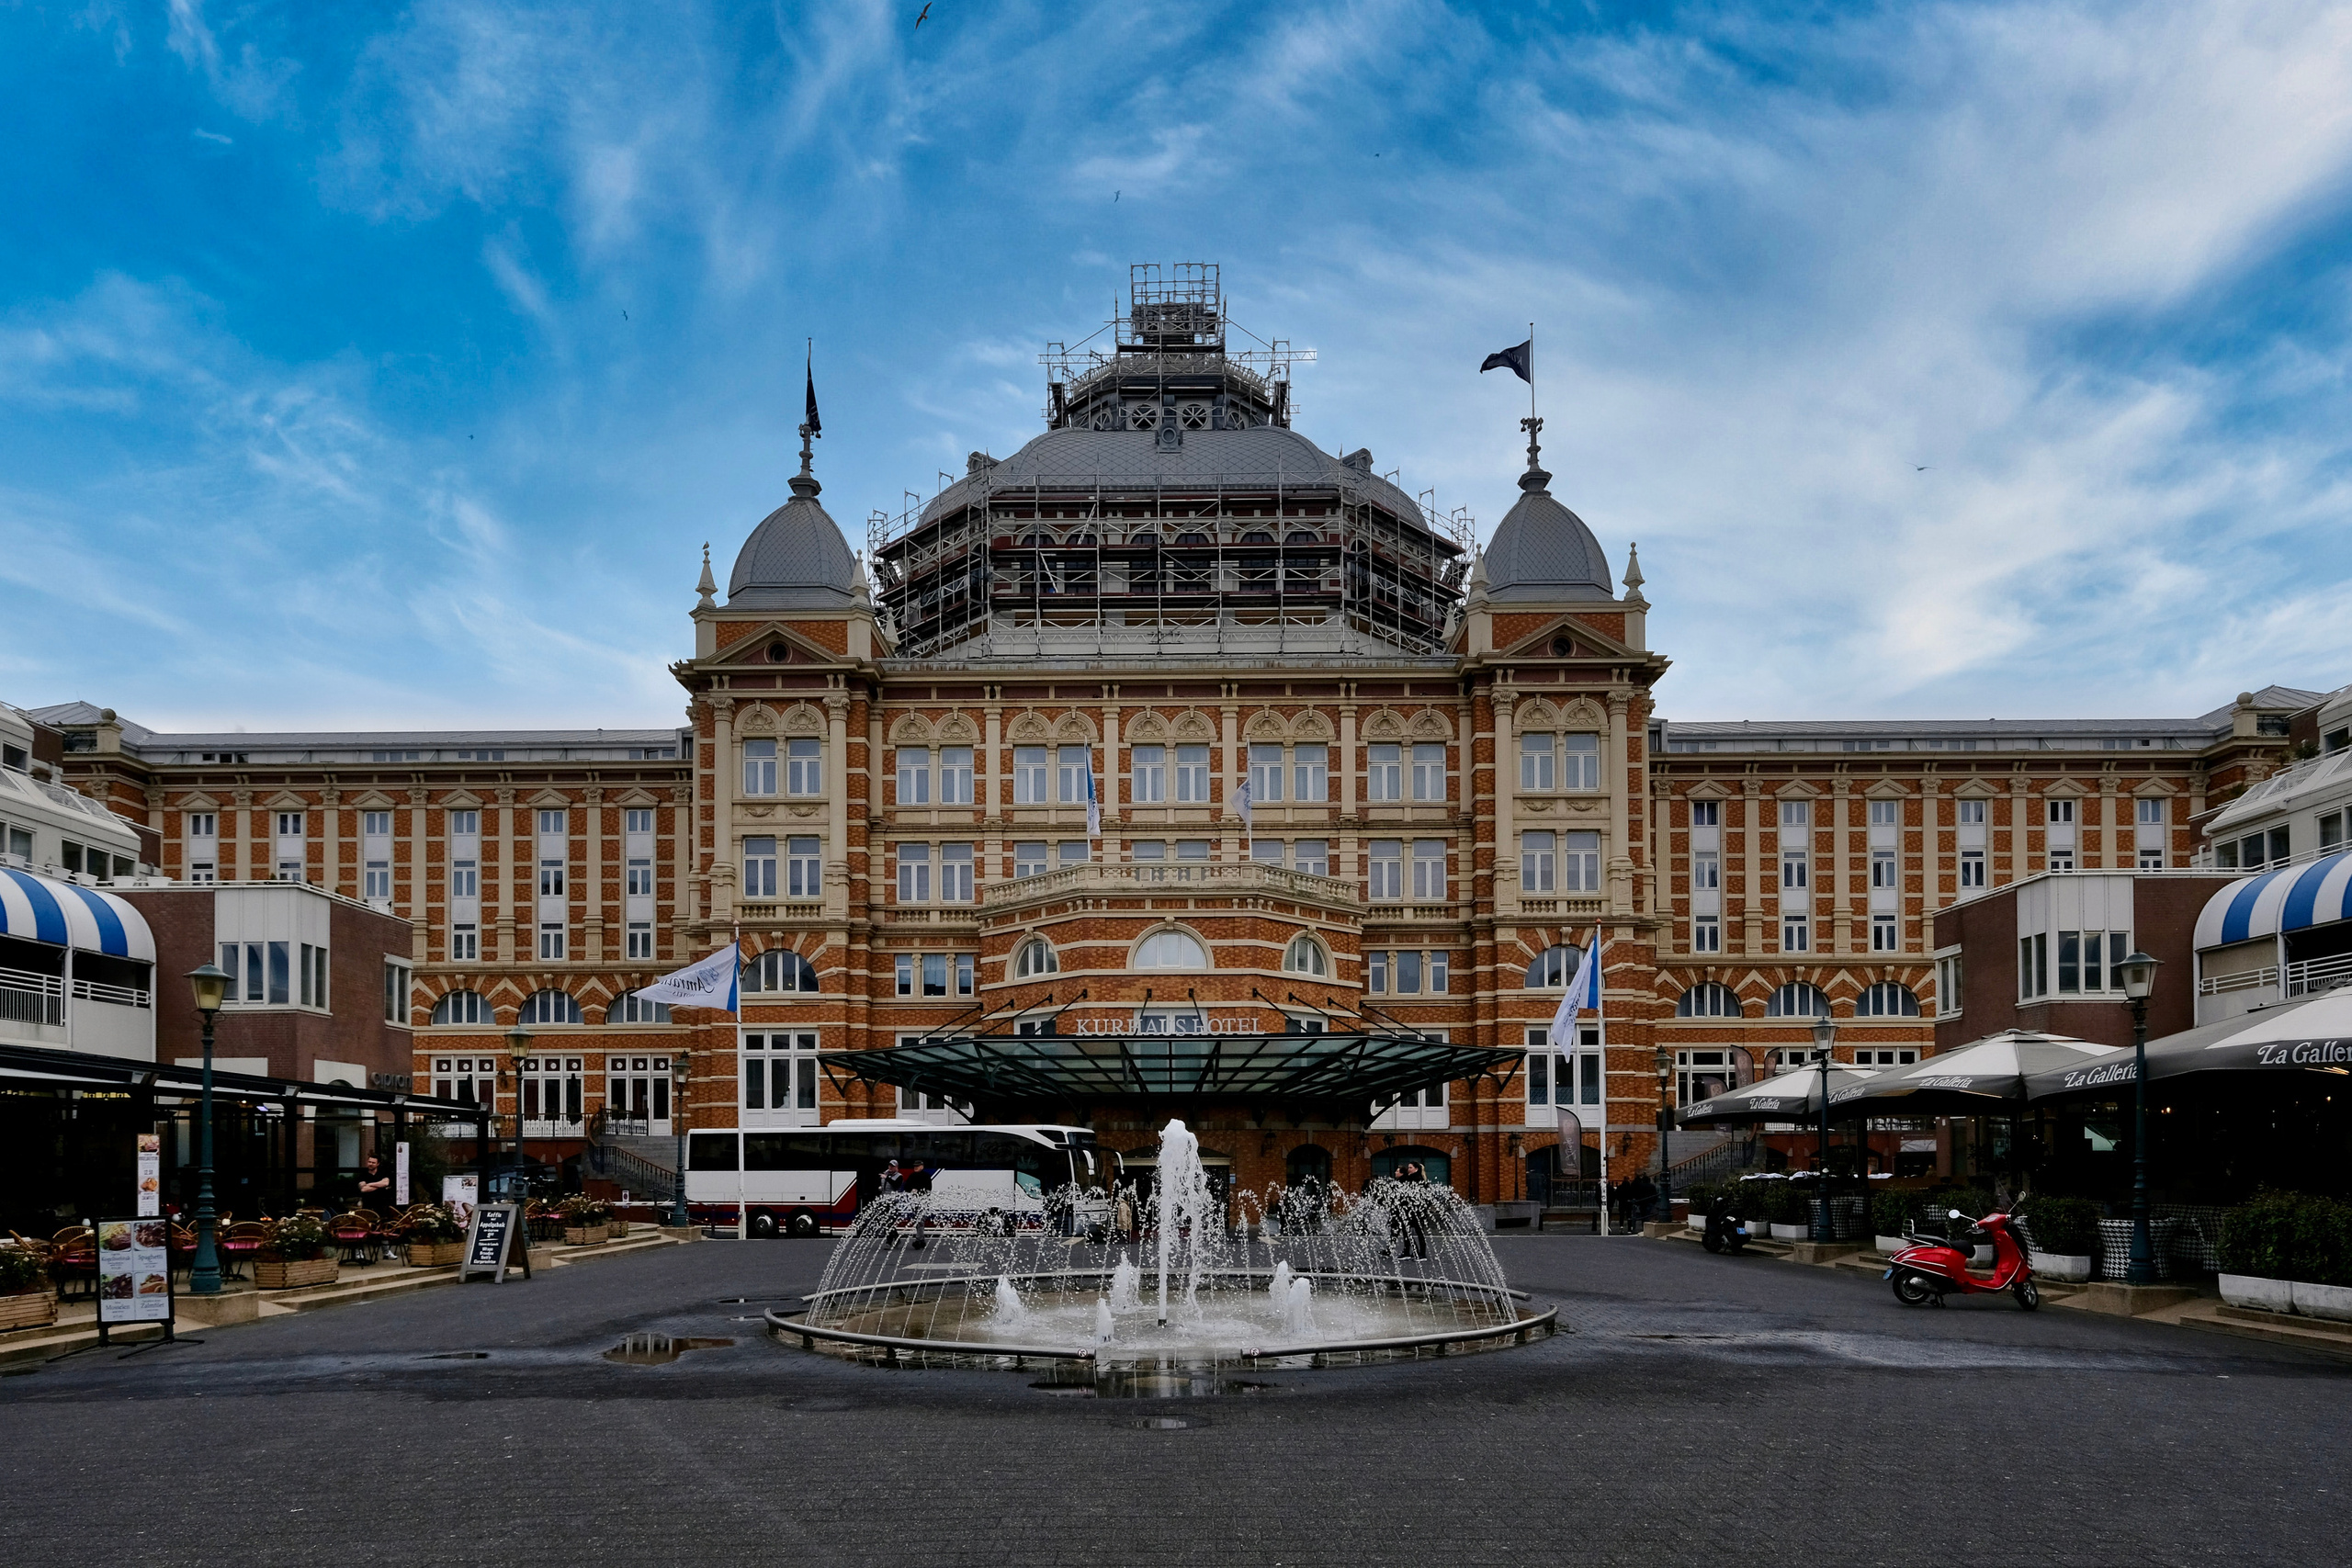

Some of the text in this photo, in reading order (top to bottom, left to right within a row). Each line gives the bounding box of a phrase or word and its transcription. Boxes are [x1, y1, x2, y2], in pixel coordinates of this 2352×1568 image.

[1076, 1018, 1266, 1036] KURHAUS HOTEL
[2256, 1043, 2288, 1065] La
[1918, 1076, 1973, 1088] La Galleria
[2064, 1071, 2086, 1088] La
[1838, 1087, 1866, 1101] Galleria
[1749, 1098, 1781, 1110] La Galleria
